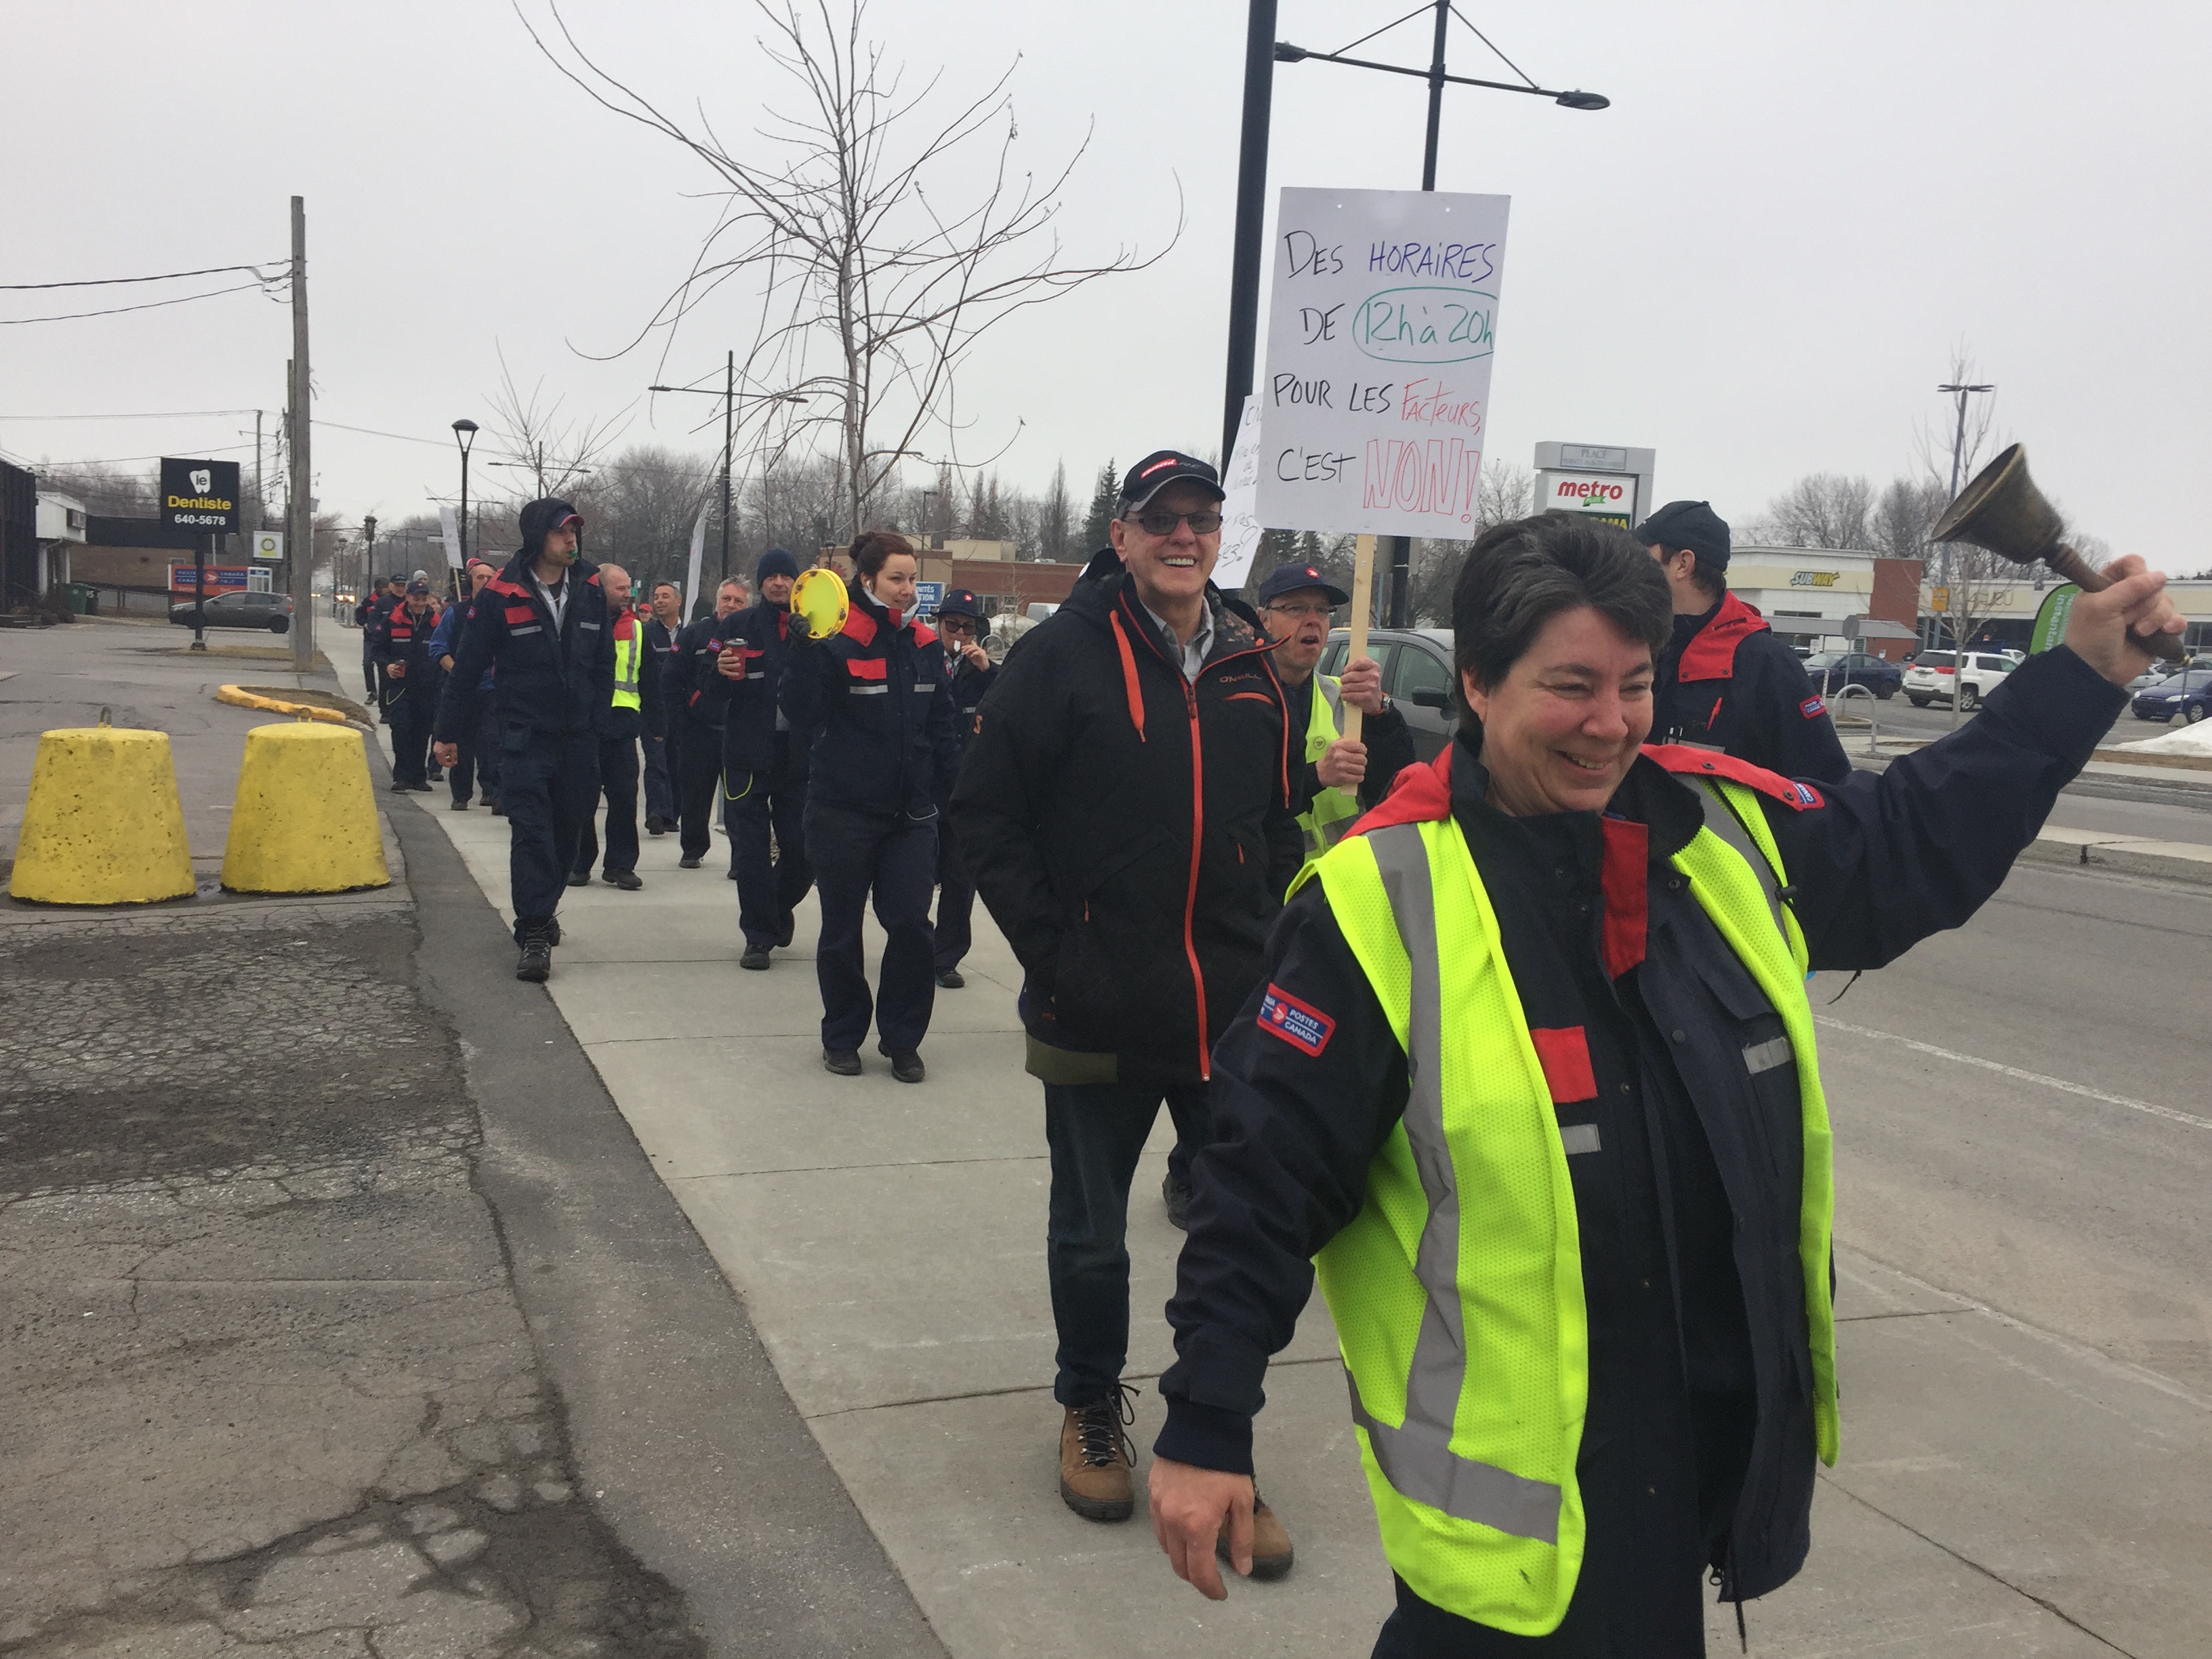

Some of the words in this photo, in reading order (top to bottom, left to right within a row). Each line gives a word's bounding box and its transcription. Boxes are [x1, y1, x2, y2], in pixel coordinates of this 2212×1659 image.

[1284, 230, 1344, 279] DES
[1299, 303, 1345, 345] DE
[1273, 373, 1333, 409] POUR
[1349, 383, 1393, 413] LES
[1363, 438, 1480, 523] NON!
[1557, 480, 1623, 500] metro
[167, 495, 232, 510] Dentiste
[174, 514, 226, 526] 640-5678
[1790, 571, 1840, 587] SUBWAY
[1289, 1008, 1319, 1029] POSTES
[1284, 1021, 1317, 1044] CANADA
